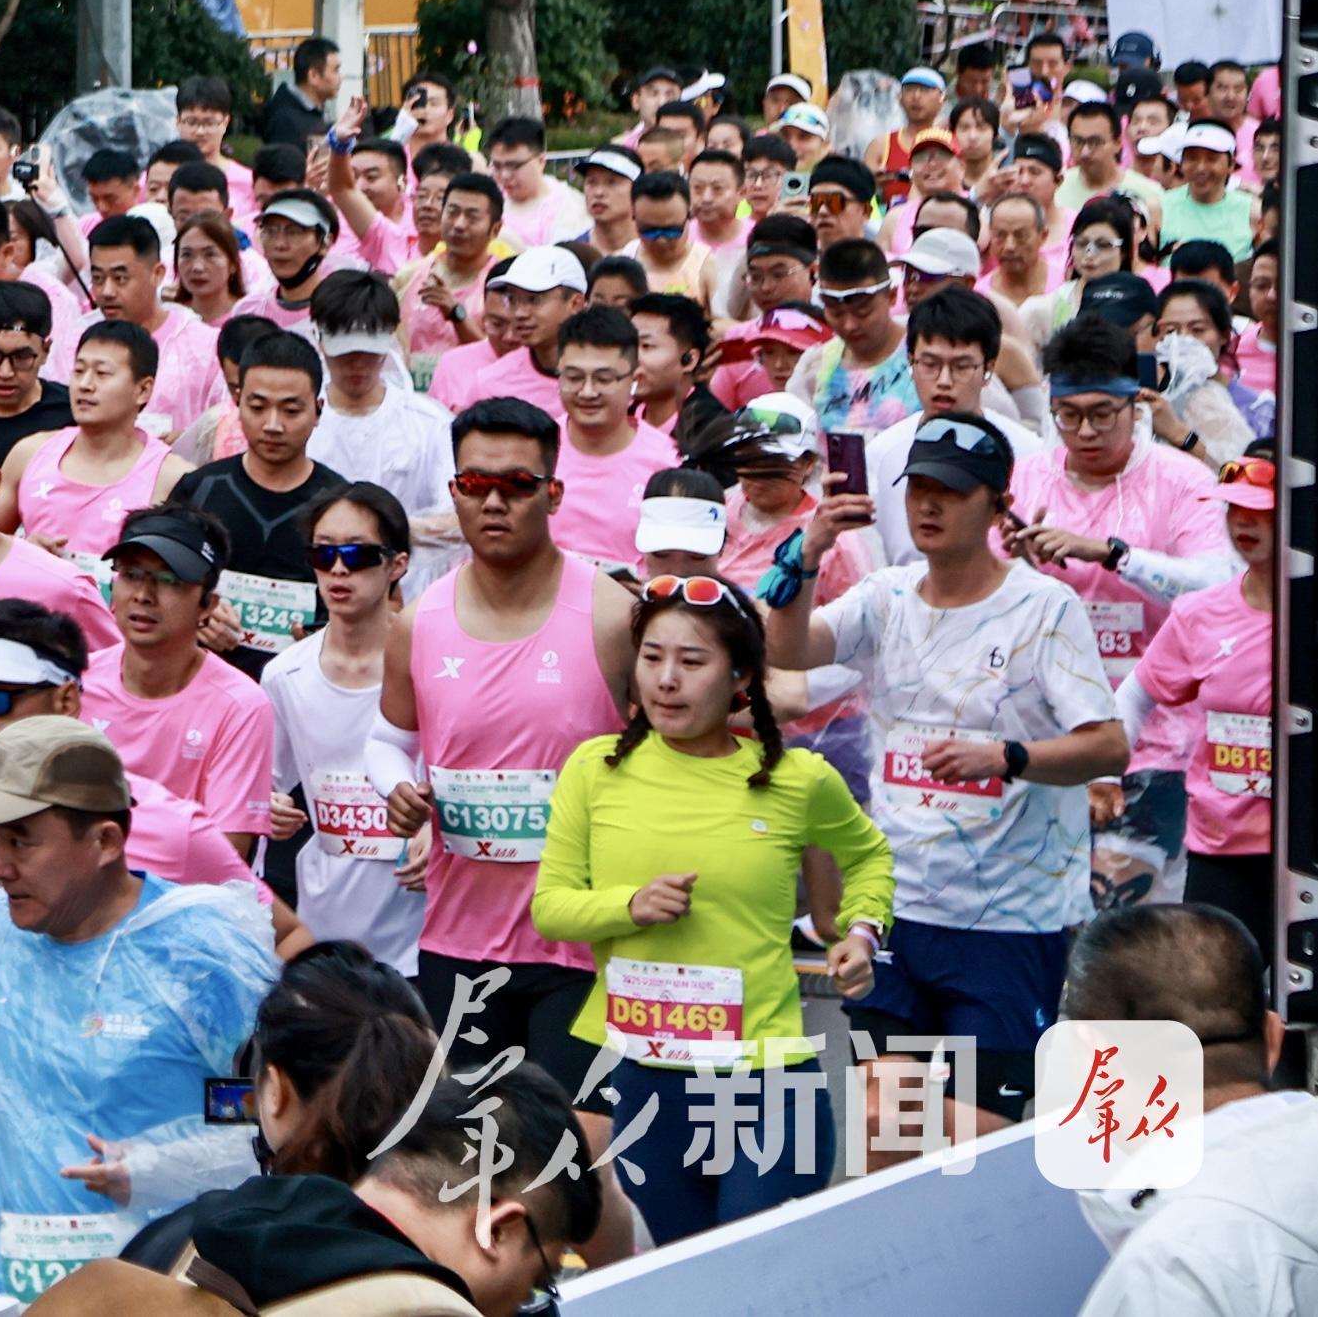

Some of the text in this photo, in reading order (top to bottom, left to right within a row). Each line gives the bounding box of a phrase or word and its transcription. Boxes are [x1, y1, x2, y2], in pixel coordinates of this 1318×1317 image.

[443, 802, 546, 833] C13075
[612, 996, 729, 1032] D61469
[8, 1259, 83, 1294] C12
